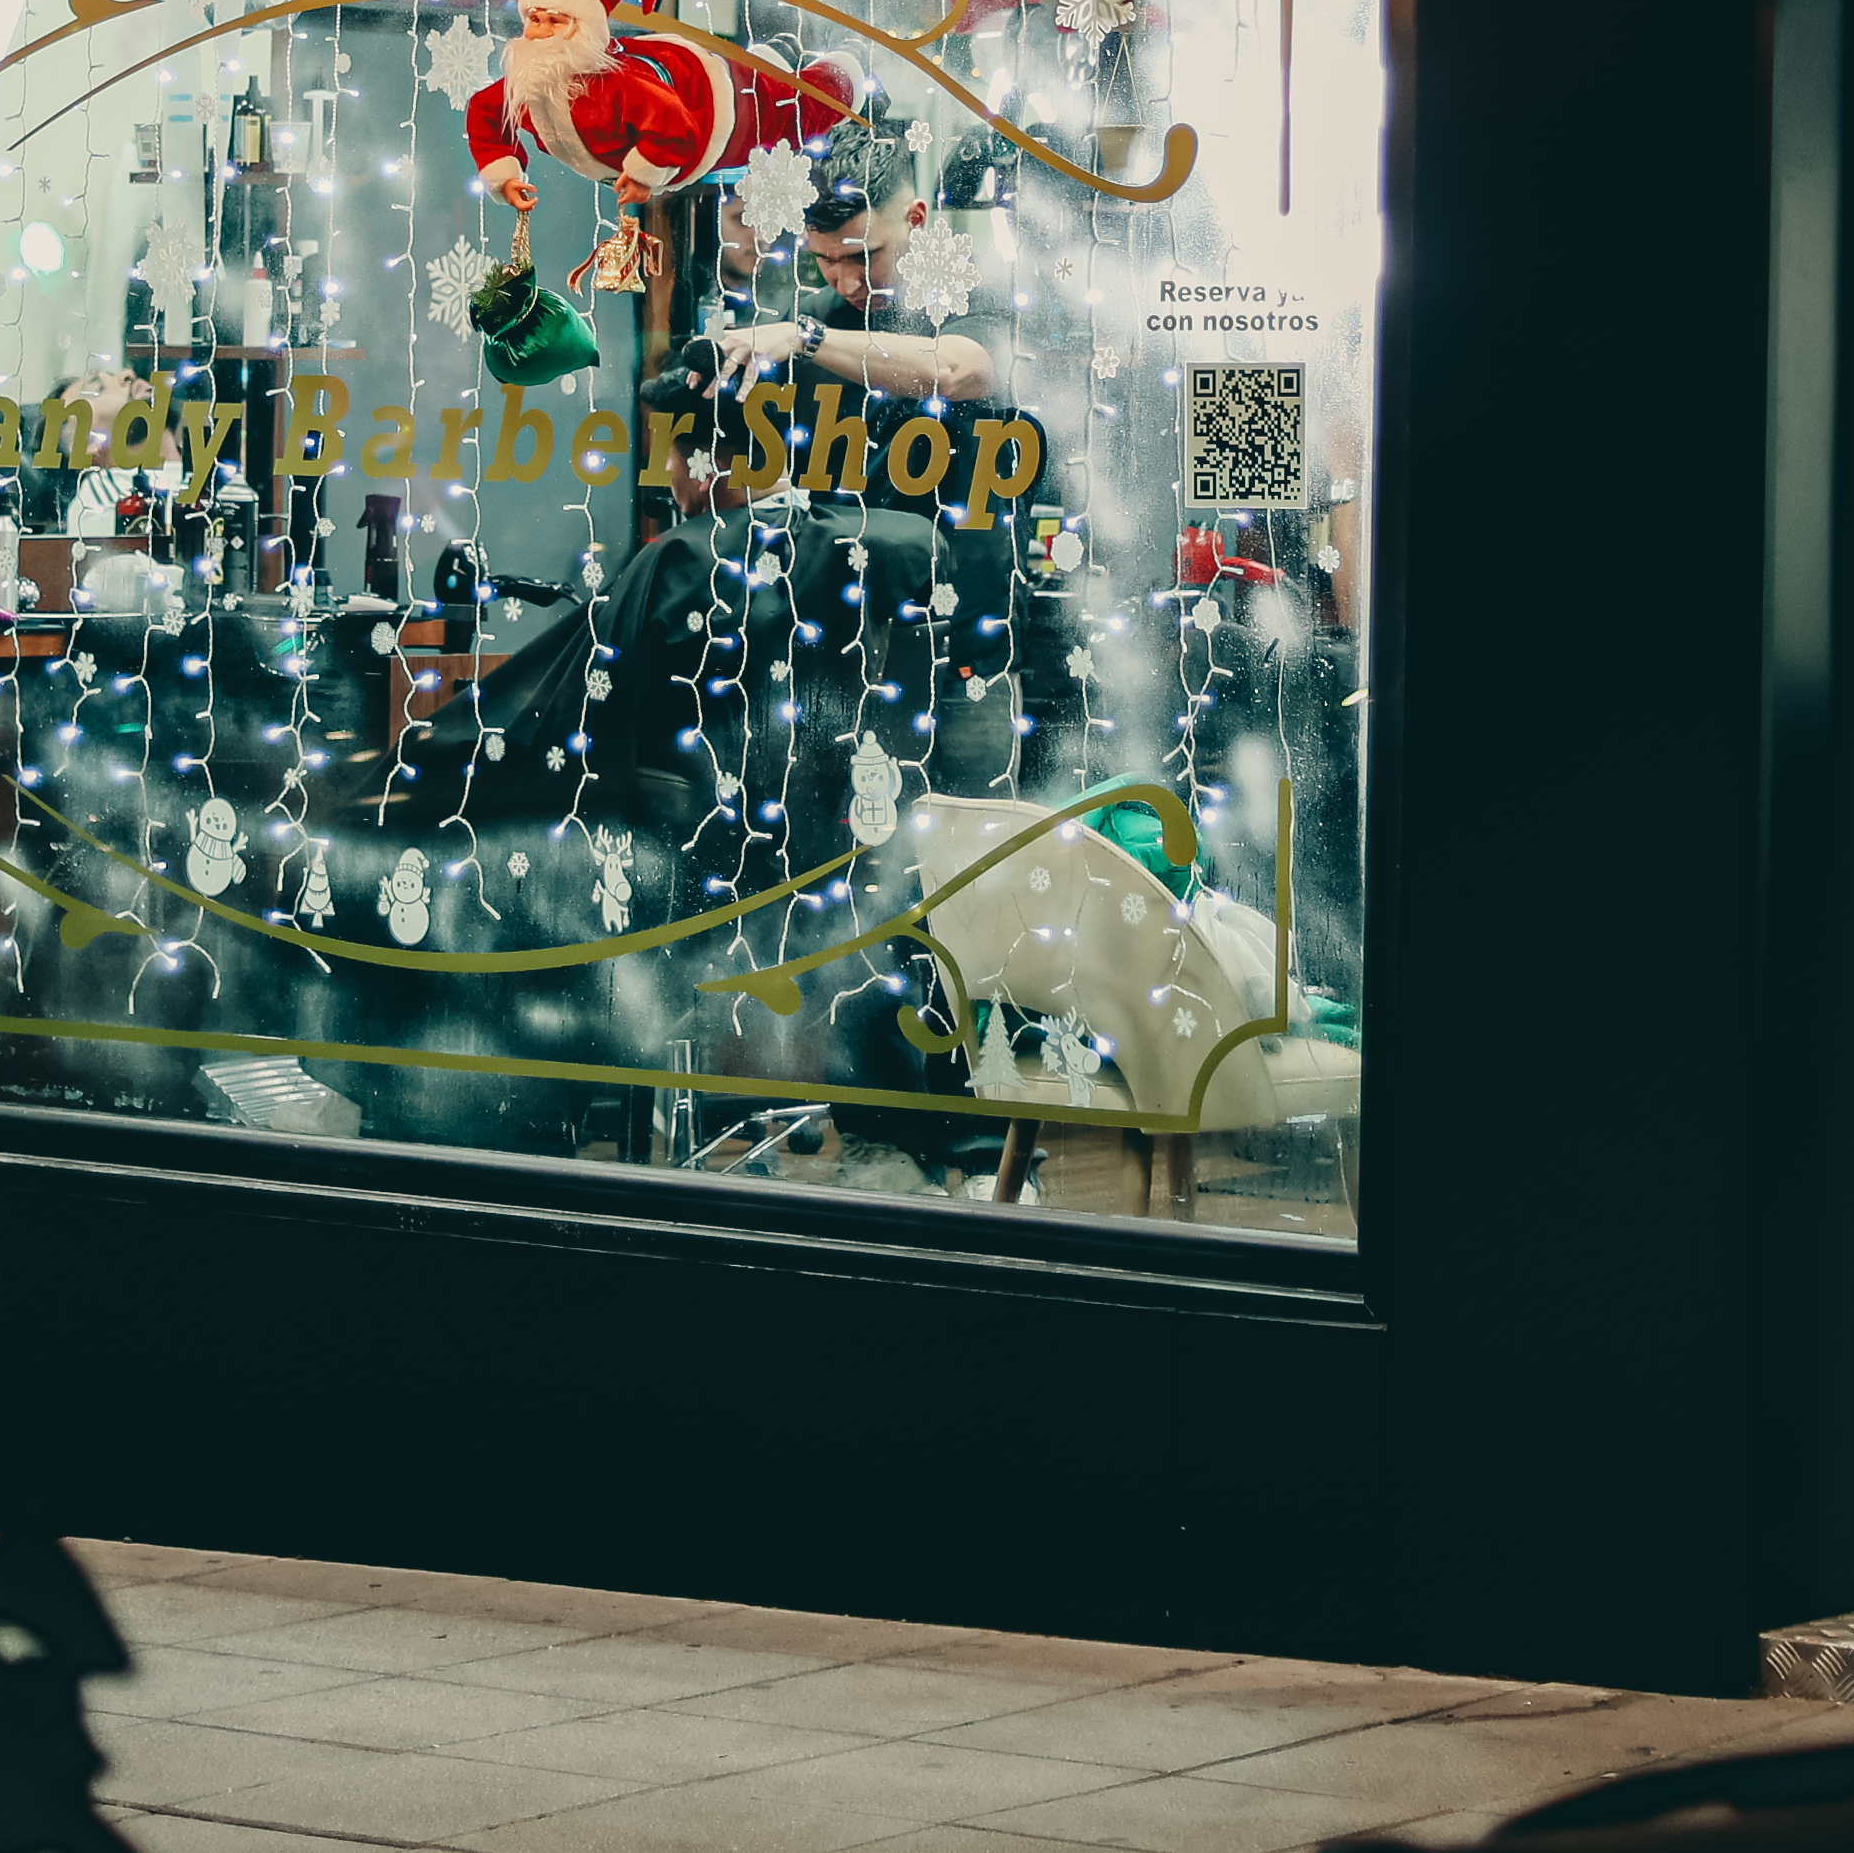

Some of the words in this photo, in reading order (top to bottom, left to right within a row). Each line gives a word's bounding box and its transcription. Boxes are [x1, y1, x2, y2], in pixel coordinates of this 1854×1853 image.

[1160, 280, 1266, 302] Reserva
[1147, 314, 1193, 331] con
[1203, 310, 1319, 331] nosotros
[274, 374, 694, 487] Barber
[726, 382, 1045, 530] Shop
